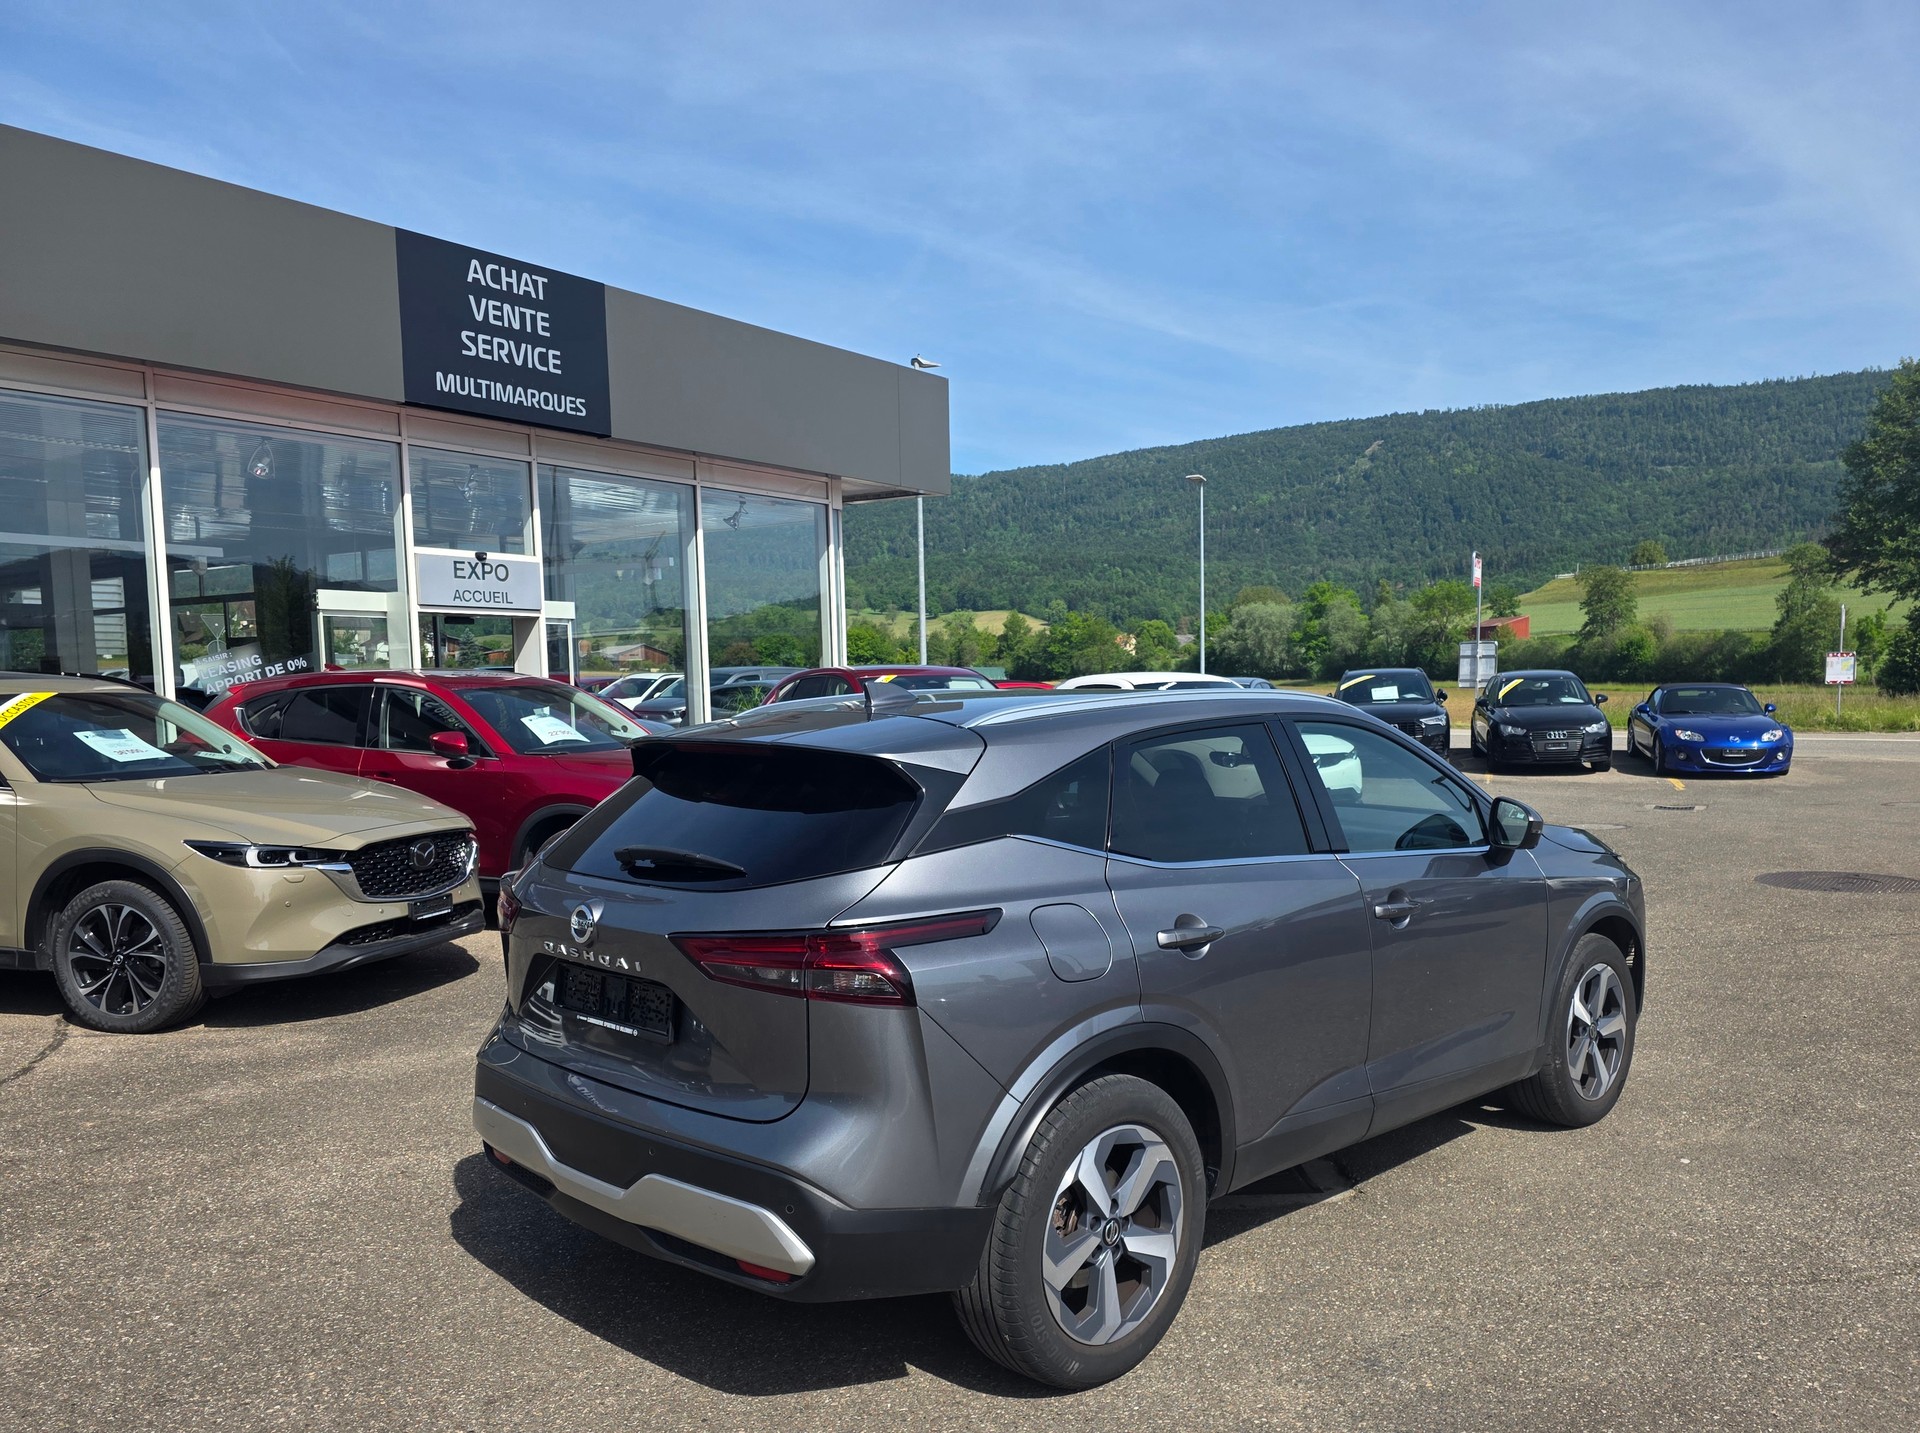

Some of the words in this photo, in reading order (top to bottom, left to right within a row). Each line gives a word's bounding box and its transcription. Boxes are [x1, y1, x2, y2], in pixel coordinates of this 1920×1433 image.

[466, 258, 548, 301] ACHAT
[468, 294, 550, 337] VENTE
[460, 330, 562, 375] SERVICE
[435, 371, 587, 417] MULTIMARQUES
[453, 560, 509, 582] EXPO
[453, 589, 514, 605] ACCUEIL
[200, 654, 262, 680] LEASING
[206, 669, 262, 695] APPORT
[265, 662, 286, 678] DE
[287, 656, 307, 671] 0%
[543, 940, 641, 972] QASHQAI
